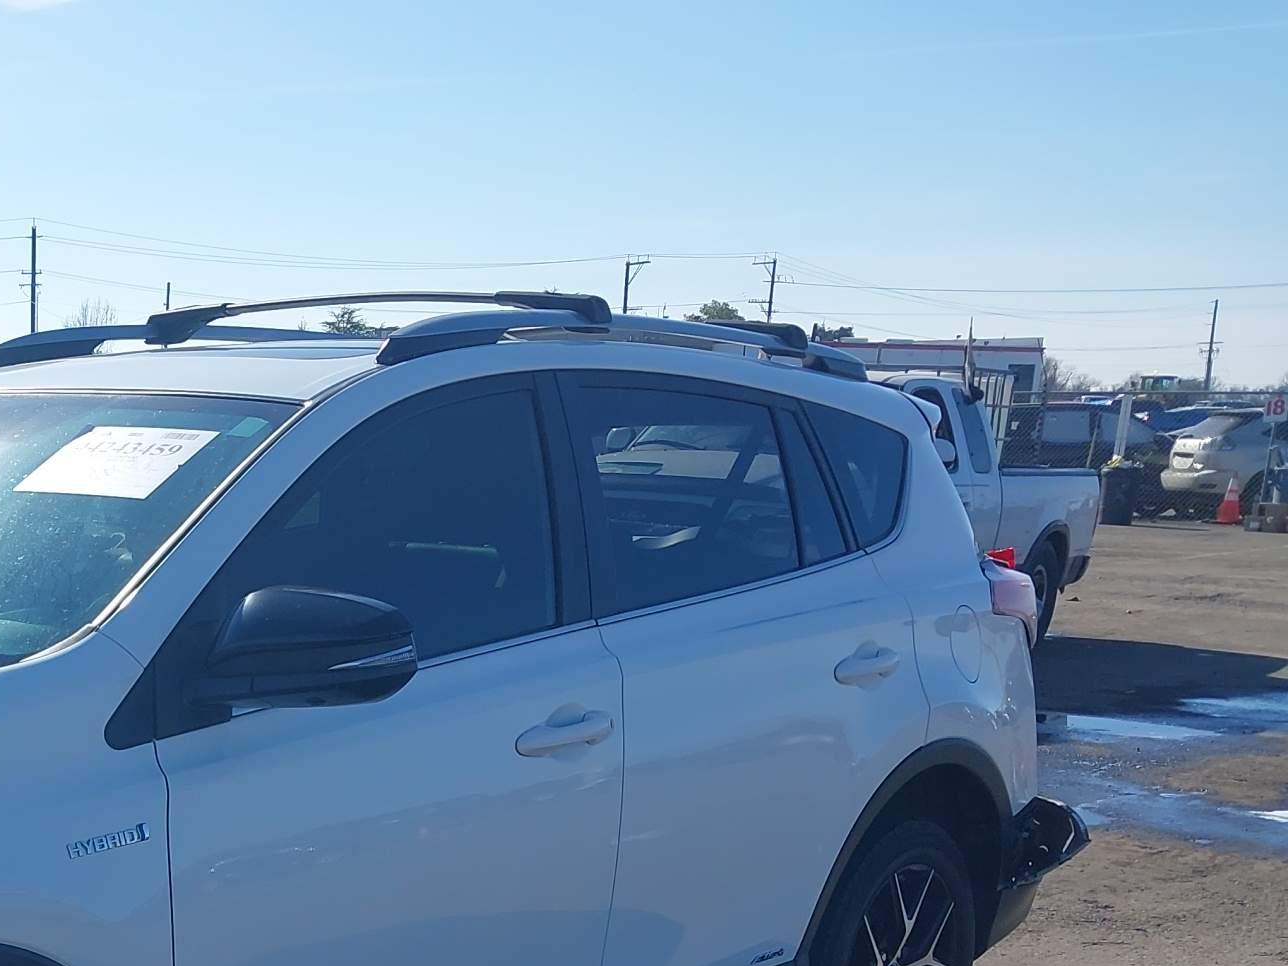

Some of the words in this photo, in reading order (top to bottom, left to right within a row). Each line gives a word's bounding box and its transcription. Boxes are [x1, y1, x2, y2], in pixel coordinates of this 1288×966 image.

[1266, 399, 1285, 416] 18
[76, 440, 183, 457] 4243459
[66, 828, 138, 859] HYBRID
